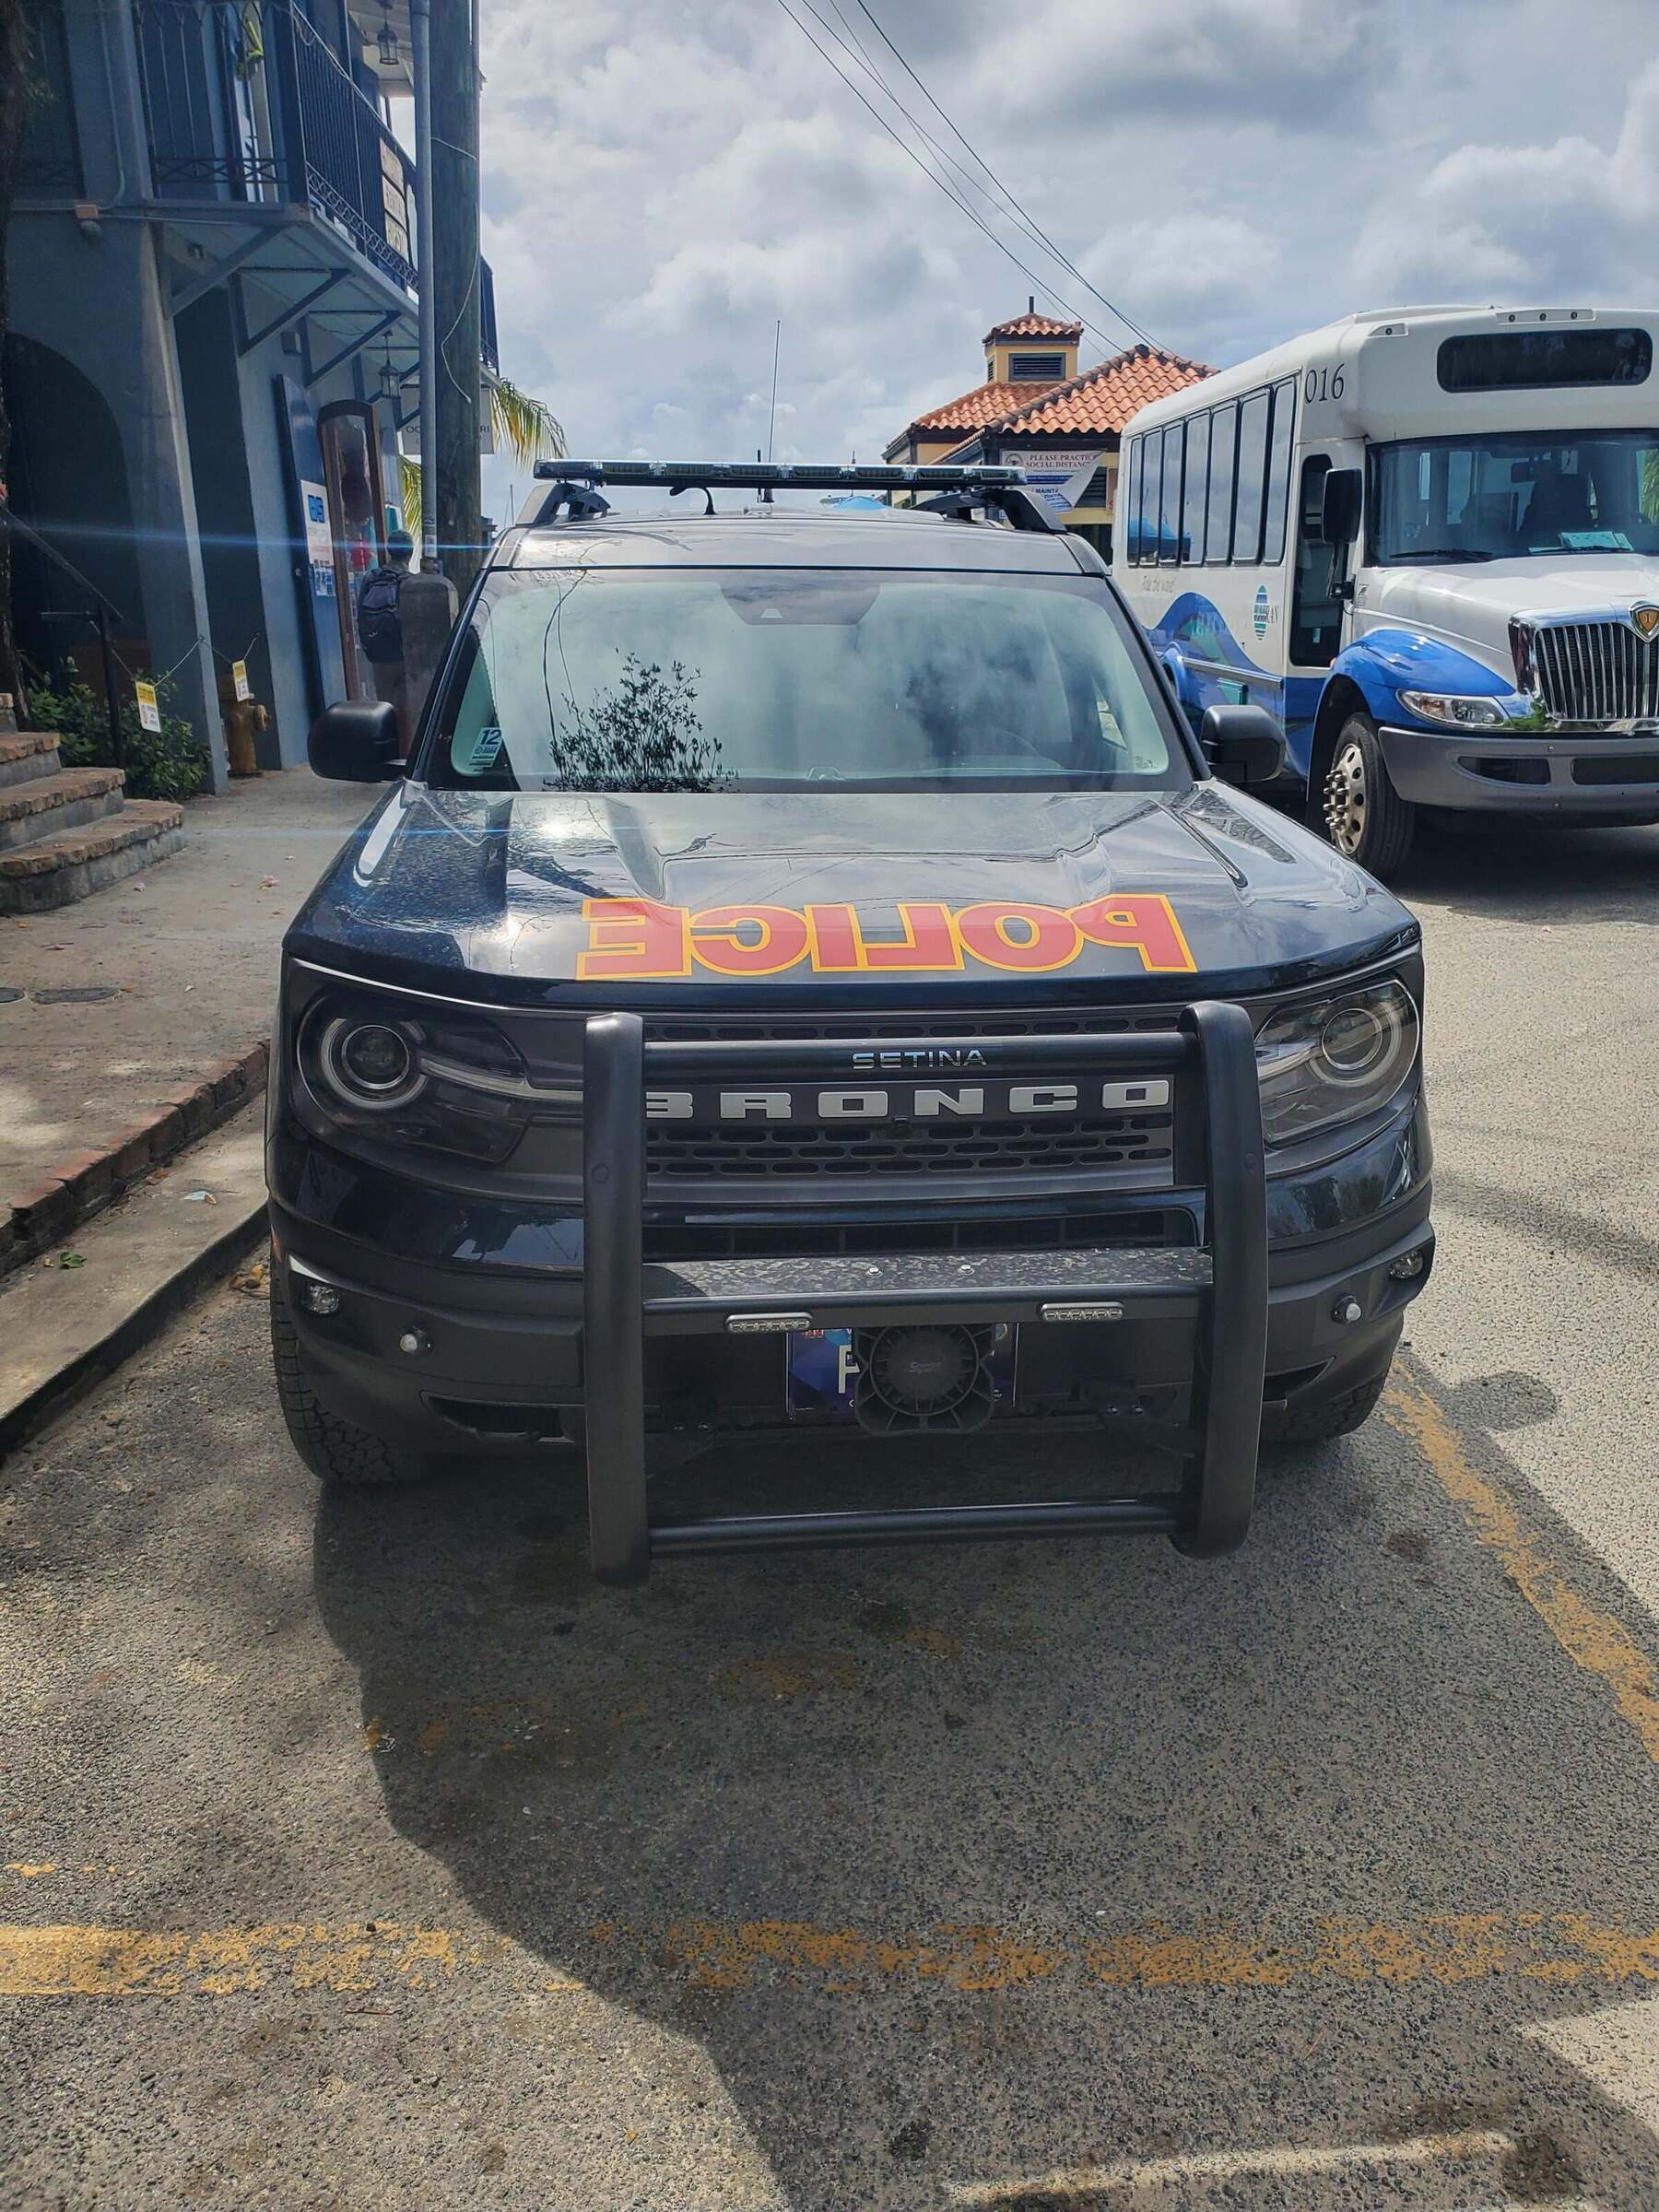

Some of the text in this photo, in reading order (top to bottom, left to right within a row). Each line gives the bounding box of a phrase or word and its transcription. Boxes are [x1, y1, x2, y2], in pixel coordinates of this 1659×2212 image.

[1305, 362, 1345, 404] 016
[481, 729, 502, 745] 12
[852, 1049, 988, 1070] SETINA
[645, 1079, 1171, 1119] BRONCO
